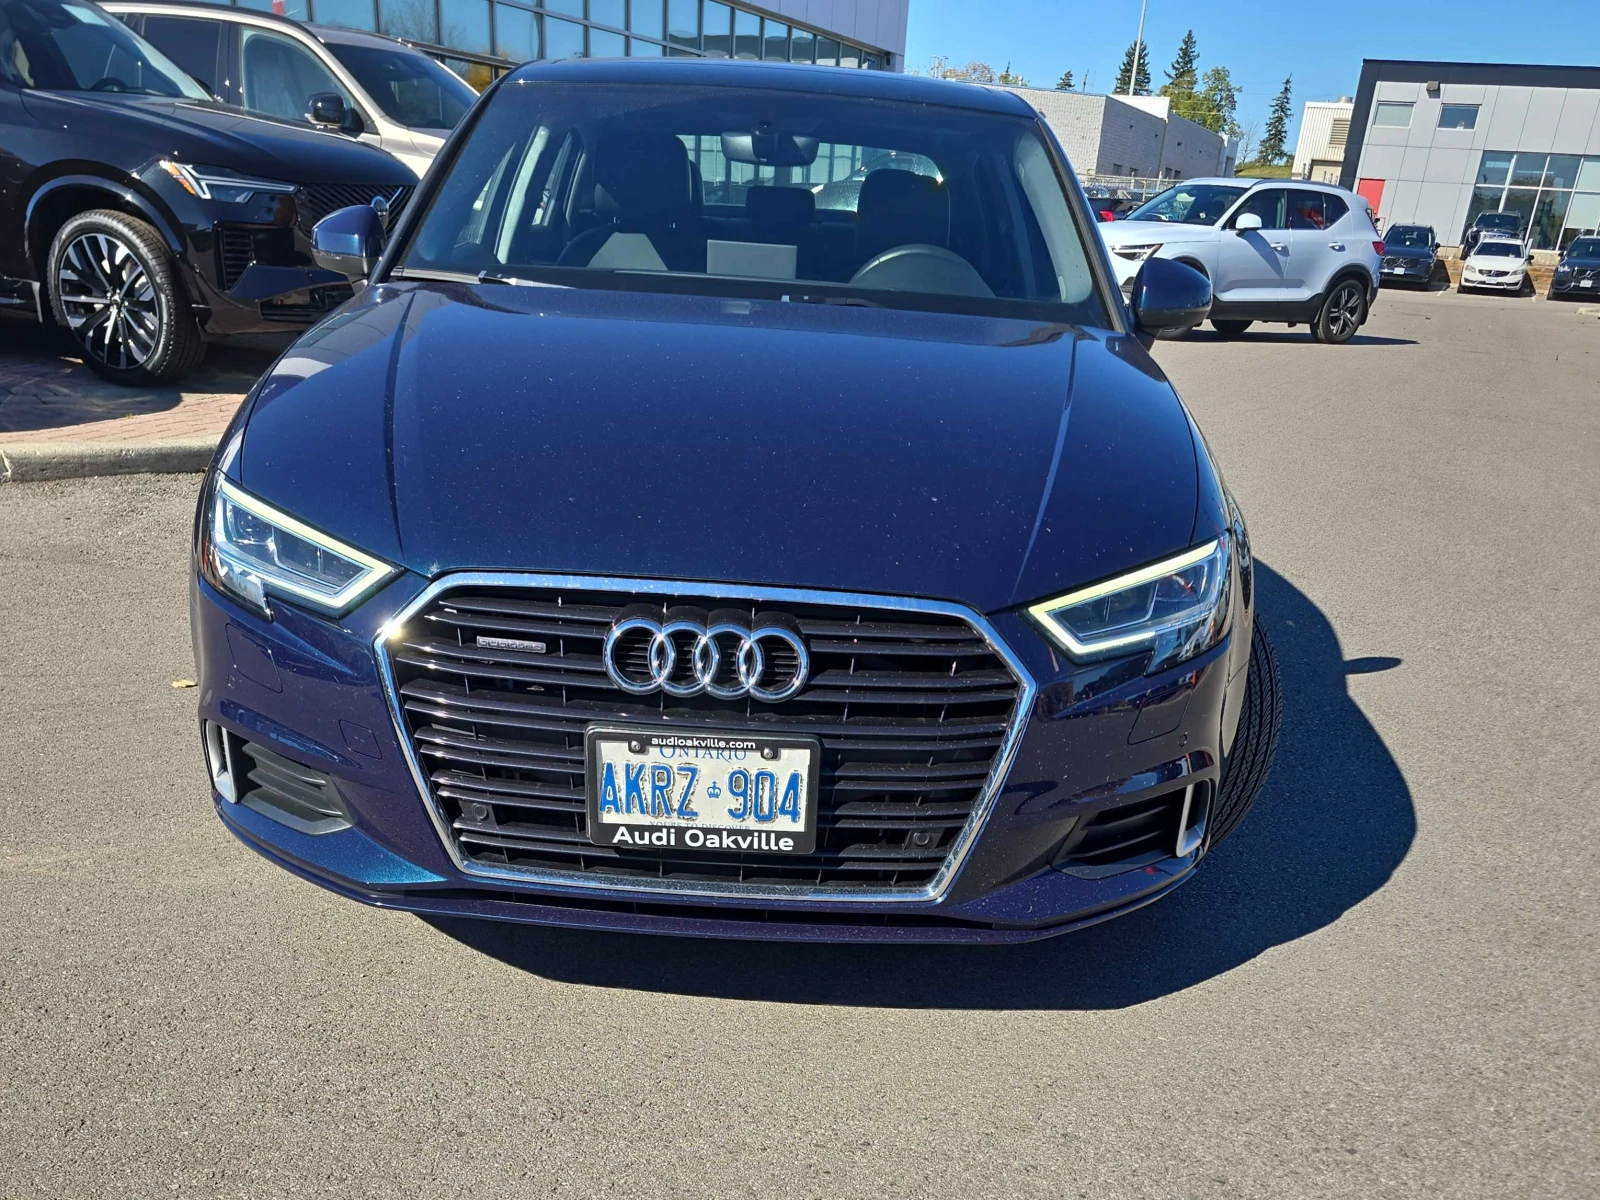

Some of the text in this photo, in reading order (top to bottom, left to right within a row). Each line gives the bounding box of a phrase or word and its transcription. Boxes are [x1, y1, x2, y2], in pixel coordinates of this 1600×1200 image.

[651, 736, 756, 749] audioakville.com
[659, 747, 747, 763] ONTARIO
[600, 762, 801, 823] AKRZ 904
[612, 826, 794, 851] Audi Oakville
